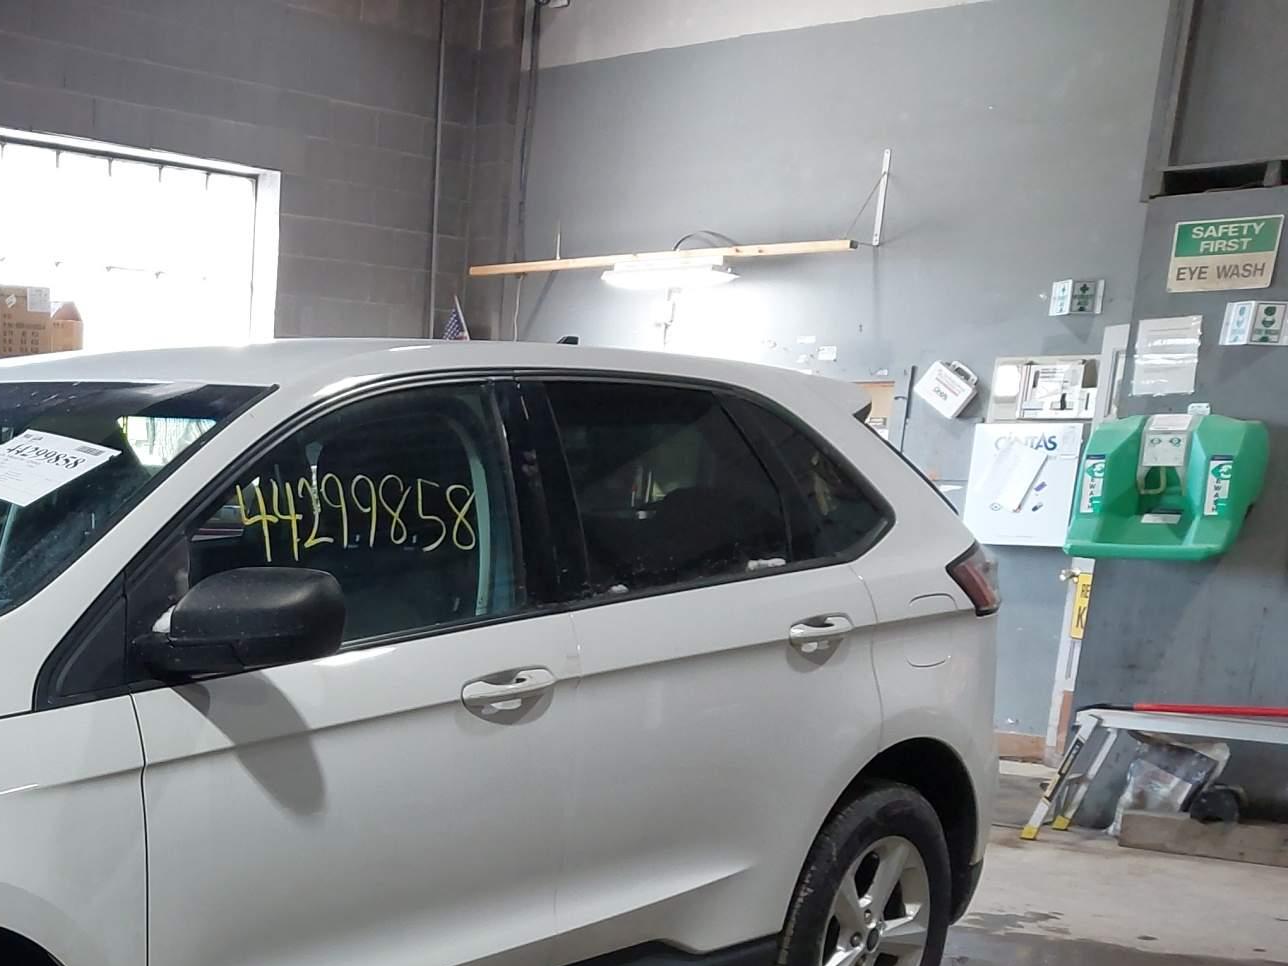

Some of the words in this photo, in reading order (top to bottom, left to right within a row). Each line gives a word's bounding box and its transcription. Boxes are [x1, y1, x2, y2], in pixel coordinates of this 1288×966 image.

[1192, 222, 1265, 239] SAFETY
[1199, 238, 1252, 253] FIRST
[1176, 266, 1208, 281] EYE
[1216, 262, 1266, 280] WASH
[994, 432, 1058, 451] CTAS
[7, 444, 86, 470] 44299858
[236, 473, 477, 562] 44299858
